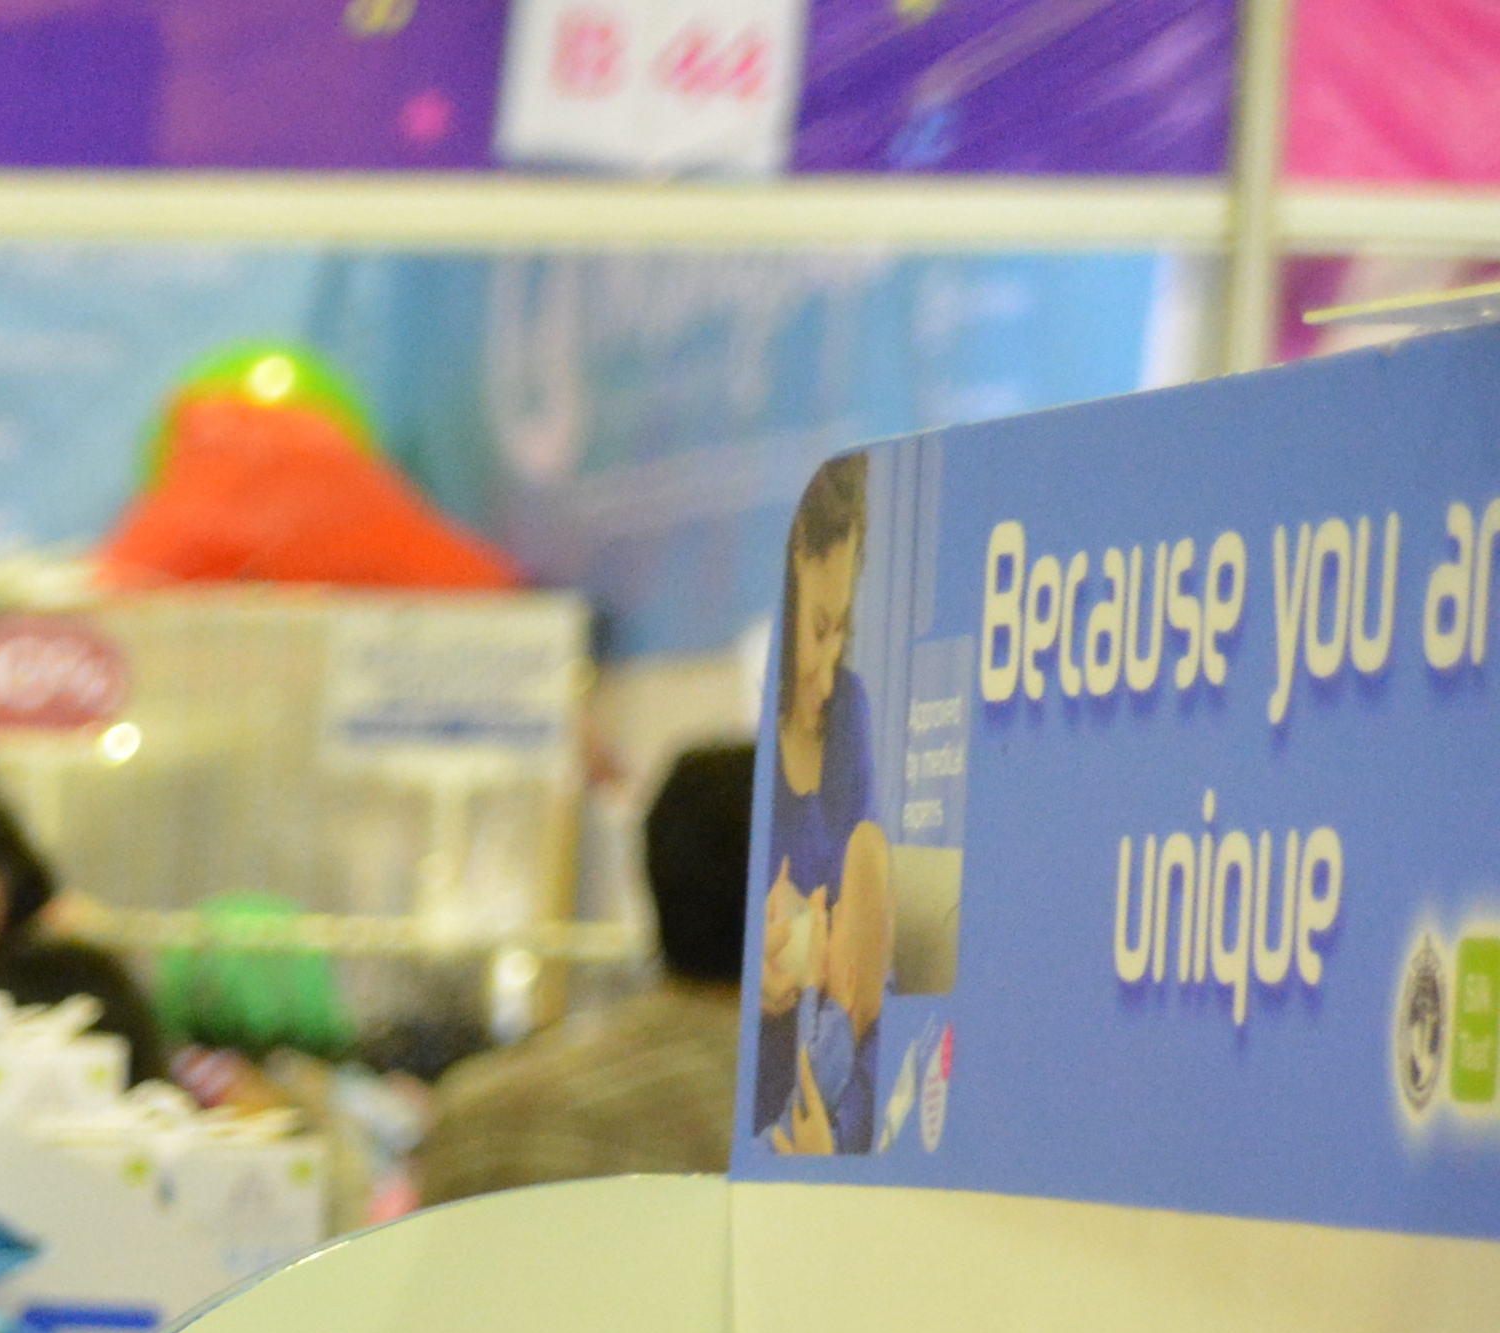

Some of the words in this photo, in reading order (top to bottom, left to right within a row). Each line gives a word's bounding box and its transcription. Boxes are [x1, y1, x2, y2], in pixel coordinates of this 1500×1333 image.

[981, 519, 1247, 702] Because
[1268, 510, 1400, 724] you
[1114, 788, 1342, 1025] unique
